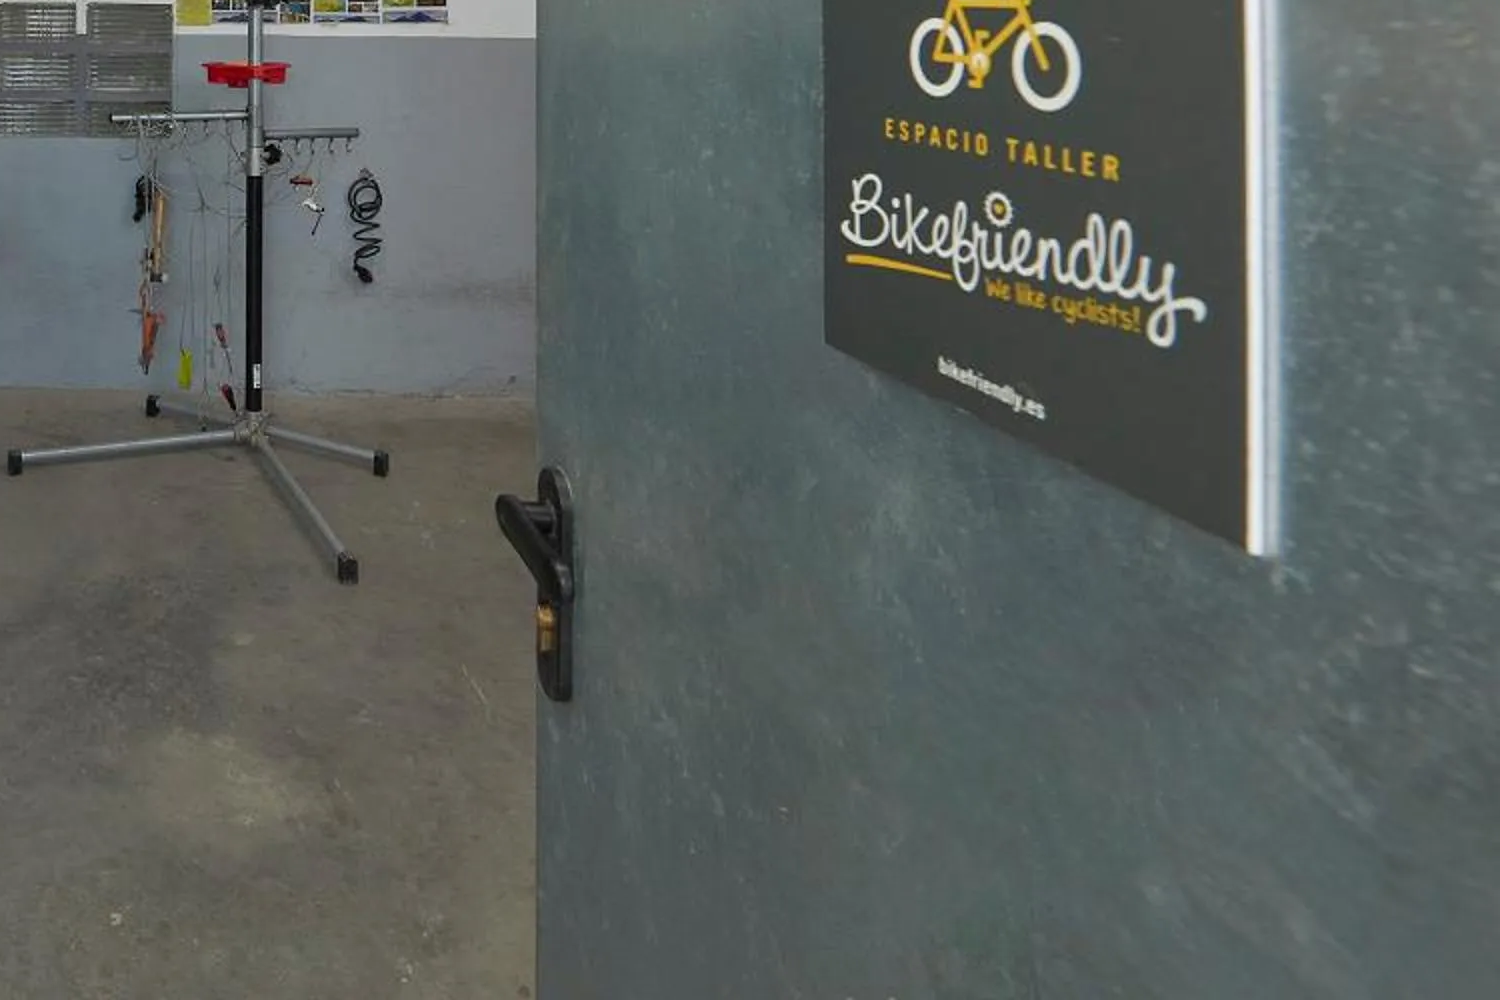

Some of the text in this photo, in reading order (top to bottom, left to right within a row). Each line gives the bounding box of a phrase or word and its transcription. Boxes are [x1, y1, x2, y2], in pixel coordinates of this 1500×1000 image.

[885, 118, 1121, 182] ESPACIO TALLER
[840, 172, 1208, 348] Bikefriendly
[1015, 281, 1046, 309] like
